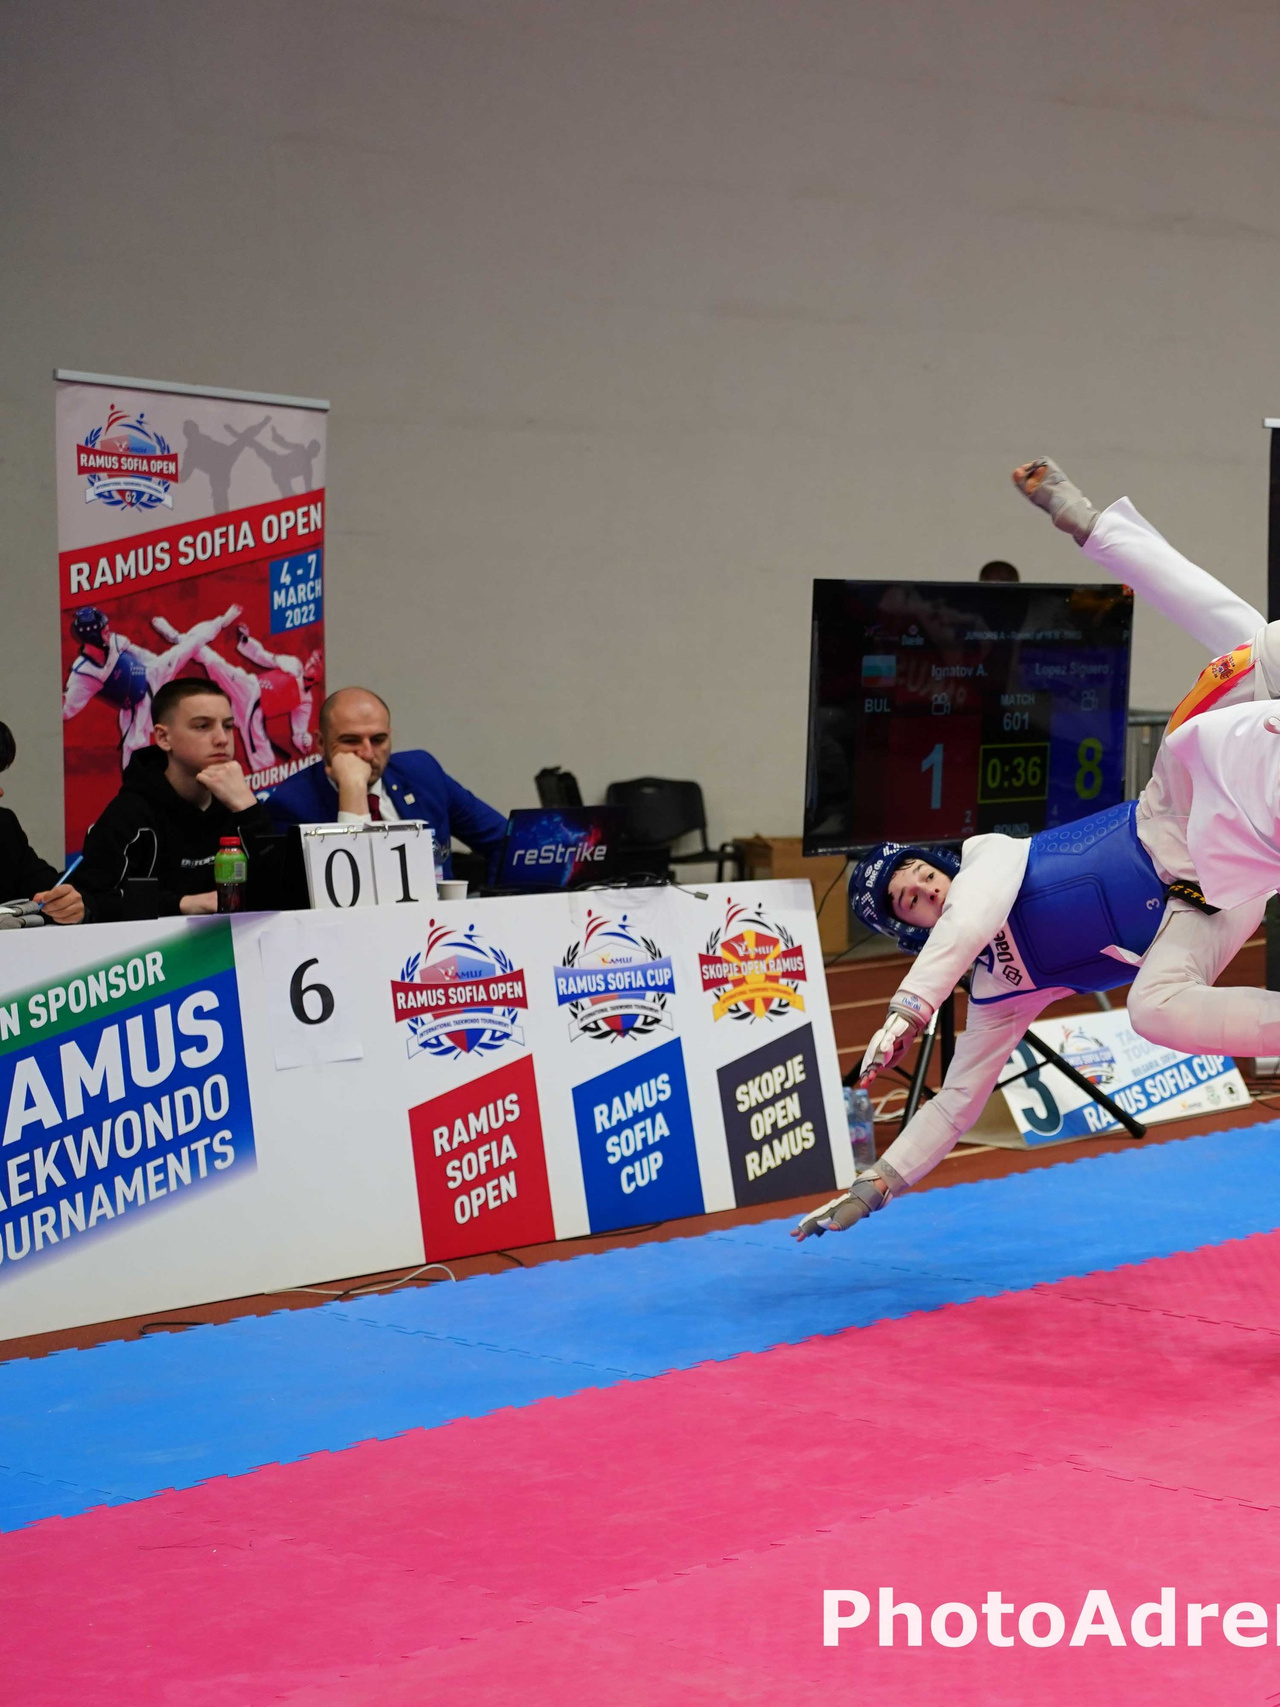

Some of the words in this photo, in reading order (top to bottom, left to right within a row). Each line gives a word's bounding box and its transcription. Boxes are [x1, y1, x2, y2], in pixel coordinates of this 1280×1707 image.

[80, 453, 119, 470] RAMUS
[120, 457, 149, 472] SOFIA
[150, 461, 176, 475] OPEN
[70, 541, 172, 594] RAMUS
[177, 520, 256, 566] SOFIA
[261, 502, 322, 544] OPEN
[279, 561, 291, 586] 4
[308, 553, 317, 577] 7
[273, 578, 322, 611] MARCH
[285, 603, 316, 629] 2022
[931, 663, 973, 677] Ignatov
[864, 698, 891, 713] BUL
[1002, 712, 1029, 730] 601
[921, 743, 943, 810] 1
[986, 756, 1042, 788] 0:36
[1075, 737, 1103, 800] 8
[964, 810, 972, 823] 2
[324, 848, 361, 908] 0
[390, 843, 419, 903] 1
[512, 843, 608, 866] reStrike
[701, 961, 740, 981] SKOPJE
[741, 959, 767, 977] OPEN
[768, 956, 805, 974] RAMUS
[993, 930, 1015, 963] Dae
[28, 950, 166, 1029] SPONSOR
[290, 957, 335, 1026] 6
[395, 986, 446, 1010] RAMUS
[448, 984, 488, 1005] SOFIA
[489, 980, 524, 1001] OPEN
[557, 973, 606, 996] RAMUS
[607, 970, 645, 991] SOFIA
[646, 968, 672, 987] CUP
[2, 989, 225, 1148] AMUS
[735, 1053, 806, 1113] SKOPJE
[1006, 1038, 1062, 1136] 3
[1147, 1069, 1191, 1108] SOFIA
[1192, 1054, 1225, 1082] CUP
[432, 1092, 520, 1158] RAMUS
[593, 1072, 672, 1134] RAMUS
[750, 1092, 802, 1142] OPEN
[0, 1073, 231, 1213] EKWONDO
[445, 1134, 518, 1190] SOFIA
[605, 1111, 670, 1165] SOFIA
[745, 1121, 816, 1182] RAMUS
[0, 1128, 236, 1268] URNAMENTS
[453, 1170, 518, 1226] OPEN
[620, 1151, 664, 1195] CUP
